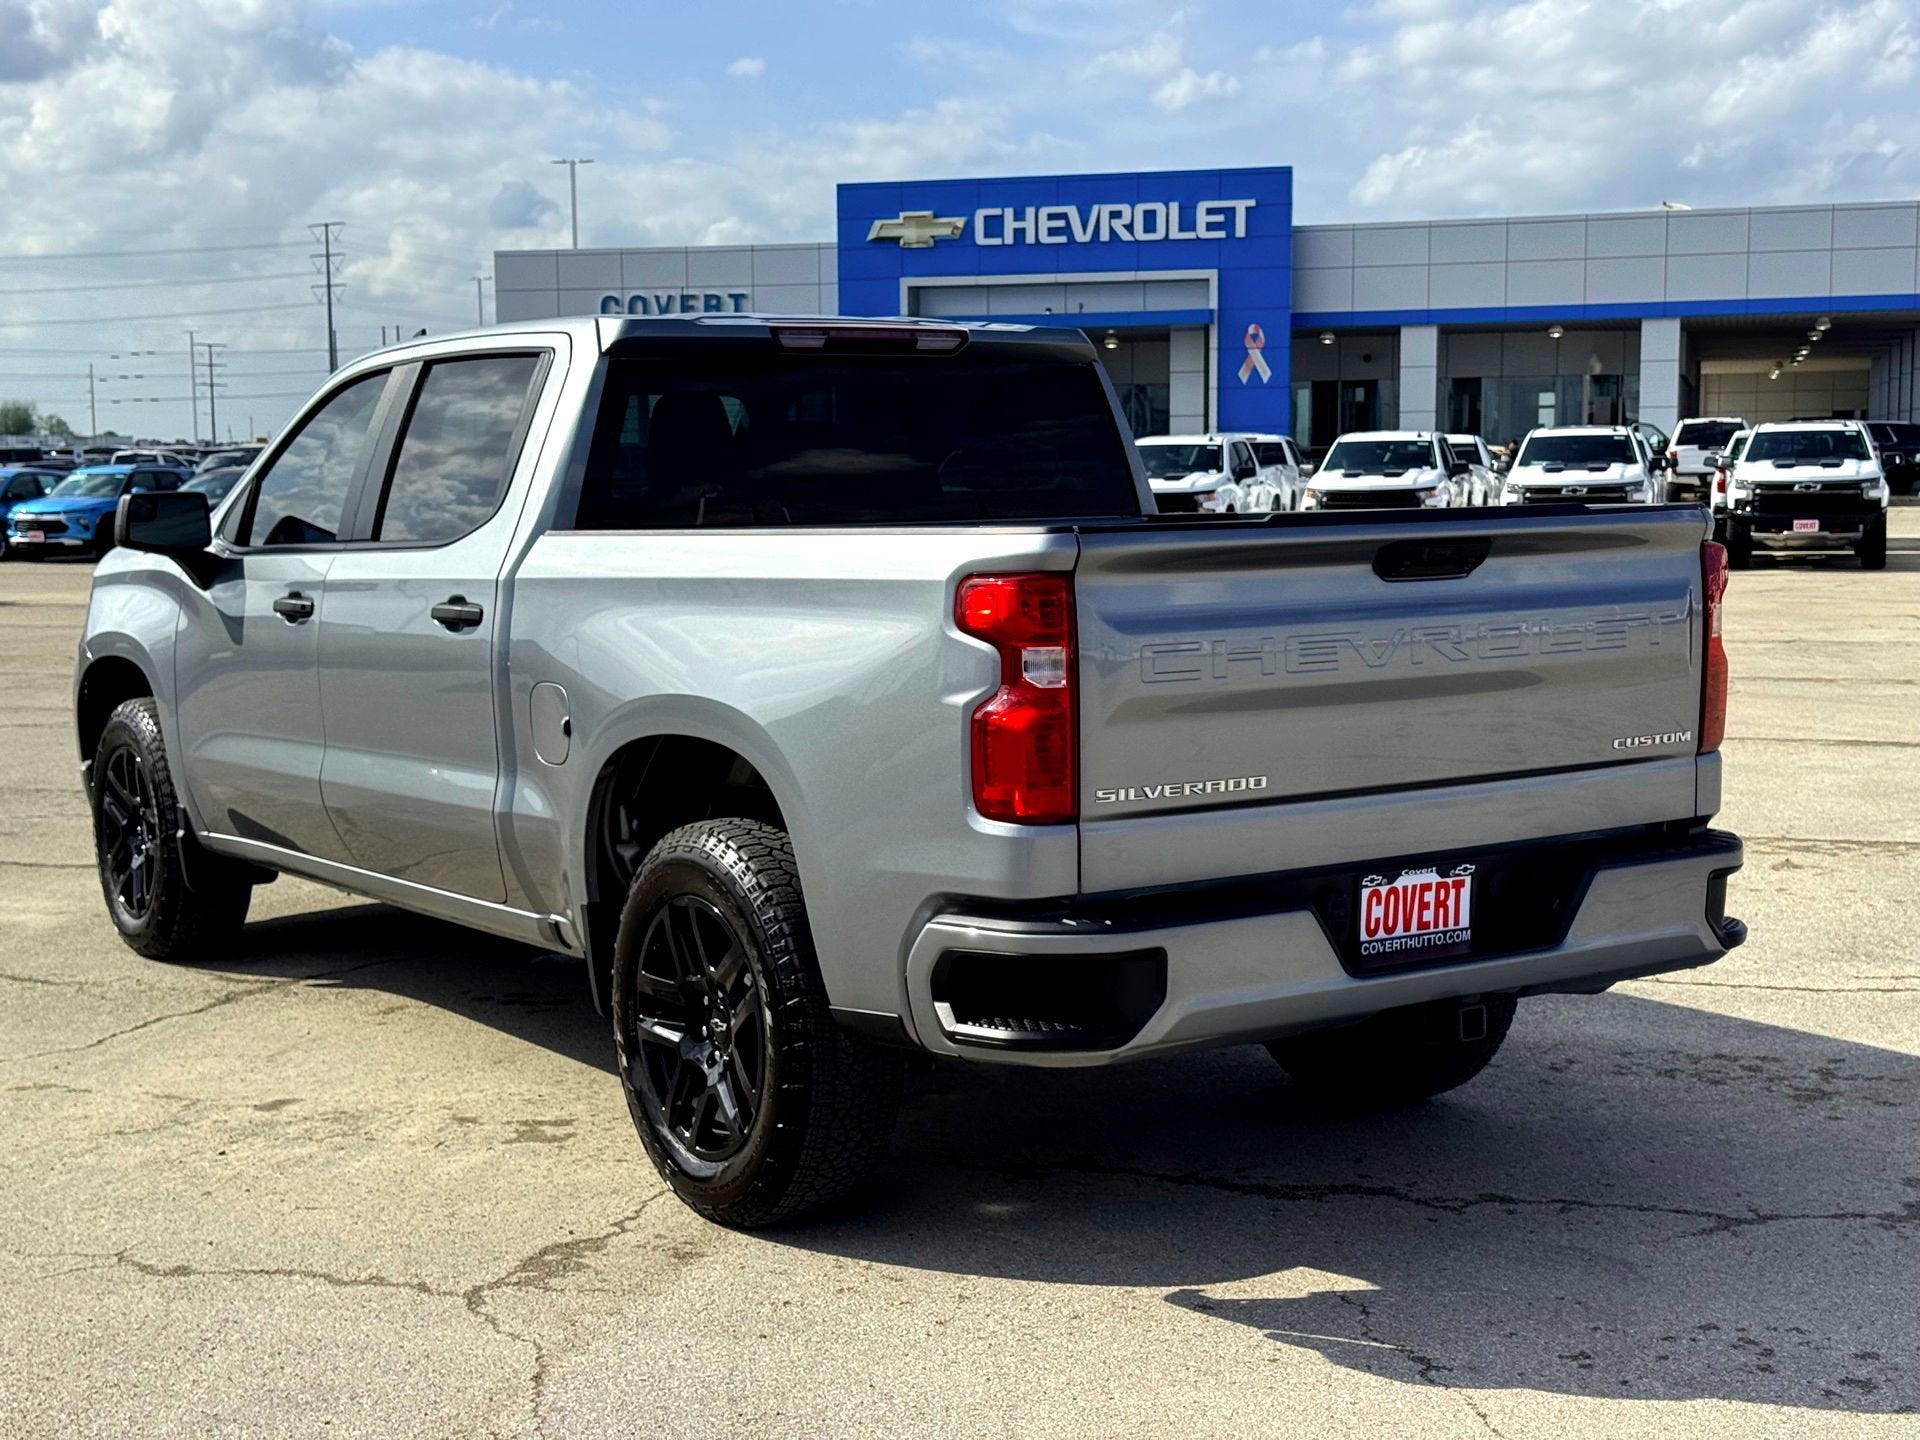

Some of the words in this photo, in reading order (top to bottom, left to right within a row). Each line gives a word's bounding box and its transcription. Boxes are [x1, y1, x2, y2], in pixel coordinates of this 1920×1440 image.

[974, 199, 1256, 245] CHEVROLET
[600, 293, 748, 315] COVERT
[1141, 609, 1686, 683] CHEVROLET
[1613, 731, 1691, 749] CUSTOM
[1095, 775, 1268, 803] SILVERADO
[1401, 867, 1437, 876] Covert
[1365, 879, 1466, 938] COVERT
[1361, 929, 1471, 955] COVERTHUTTO.COM
